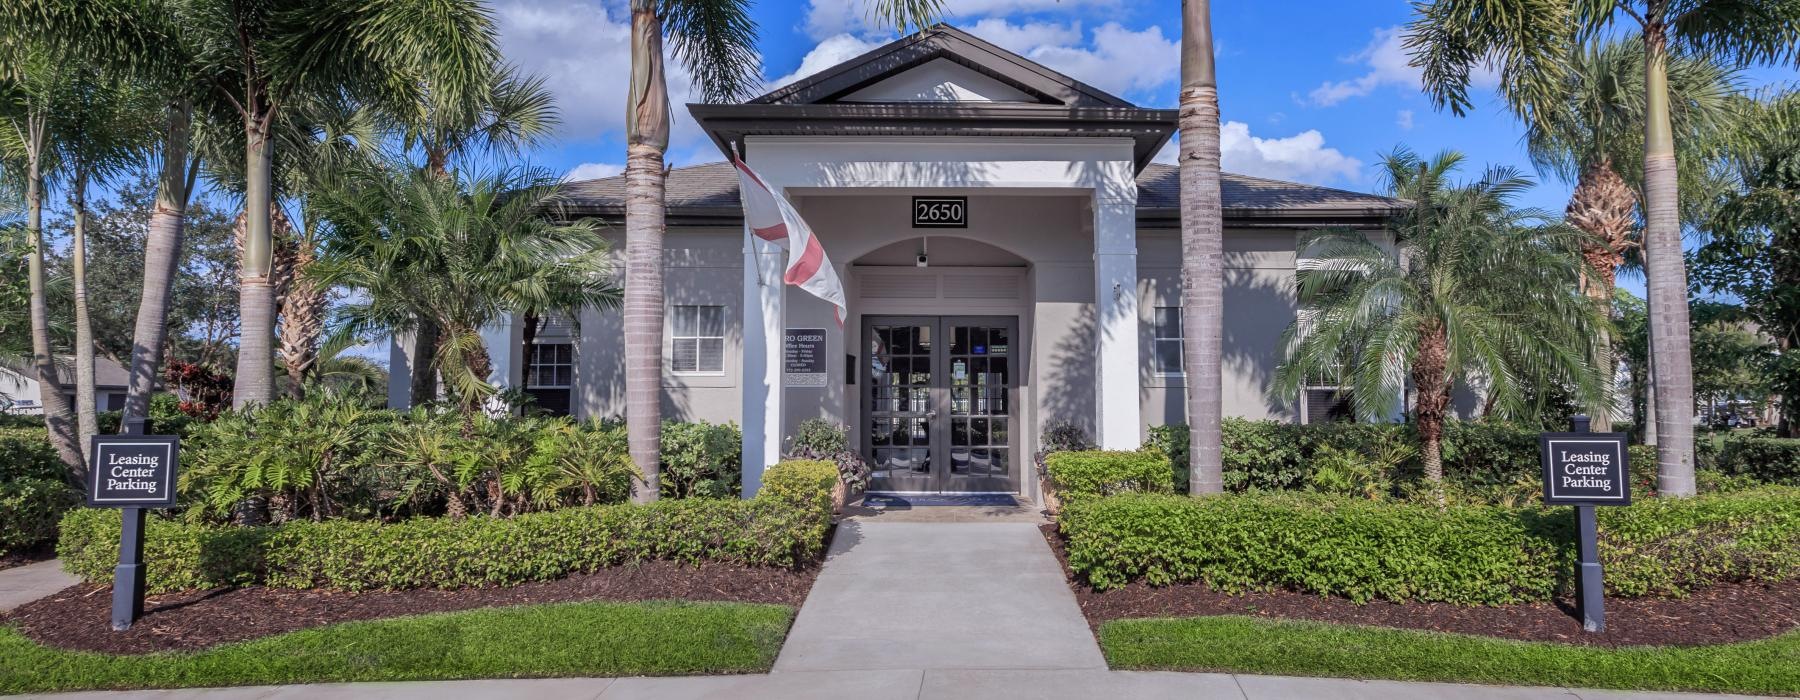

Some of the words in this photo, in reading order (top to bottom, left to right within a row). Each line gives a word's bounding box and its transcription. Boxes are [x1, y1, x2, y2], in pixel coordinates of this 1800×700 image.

[918, 203, 962, 220] 2650
[108, 453, 160, 468] Leasing
[1561, 450, 1611, 466] Leasing
[111, 466, 155, 478] Center
[1564, 463, 1608, 475] Center
[106, 478, 158, 493] Parking
[1562, 476, 1612, 491] Parking
